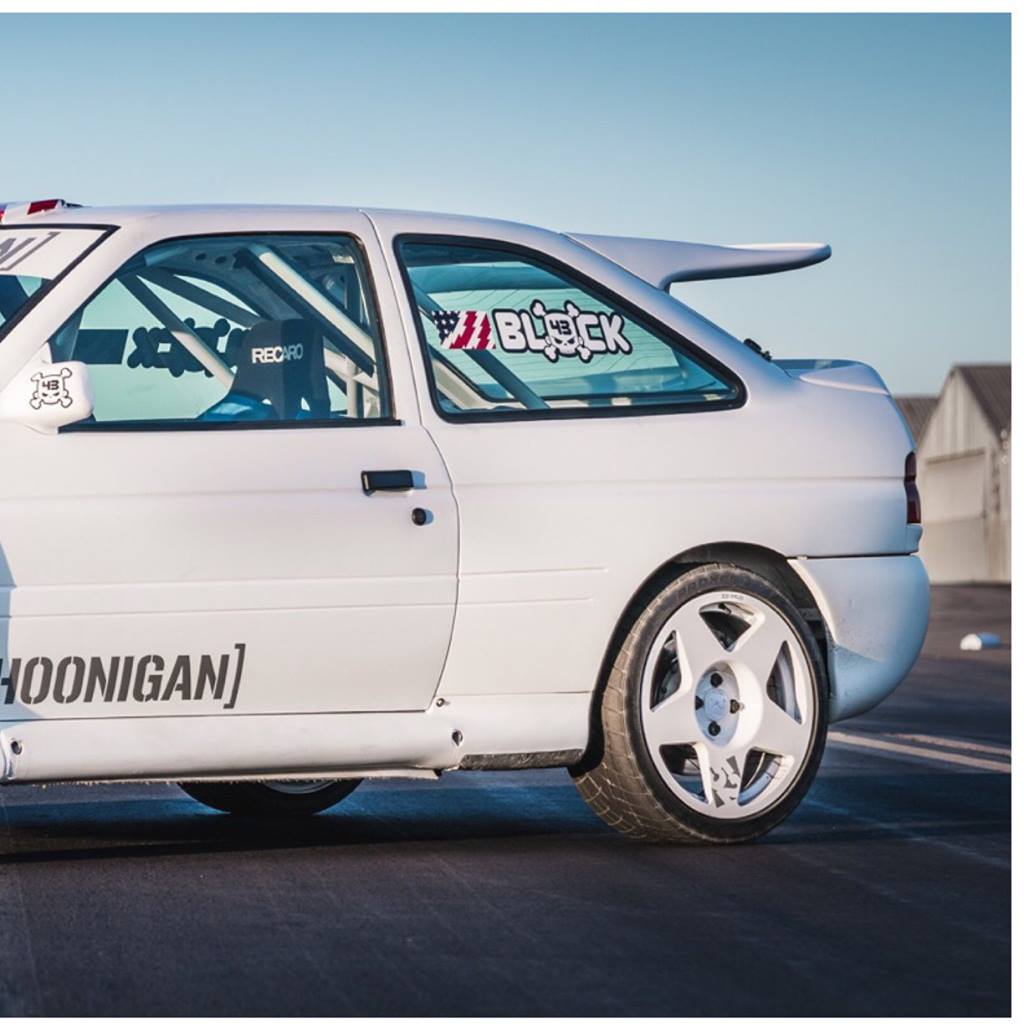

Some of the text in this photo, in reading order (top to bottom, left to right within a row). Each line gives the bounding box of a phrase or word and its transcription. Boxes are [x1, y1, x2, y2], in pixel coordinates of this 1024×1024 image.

[549, 319, 573, 336] 43
[251, 344, 304, 364] RECARO
[42, 378, 61, 392] 43
